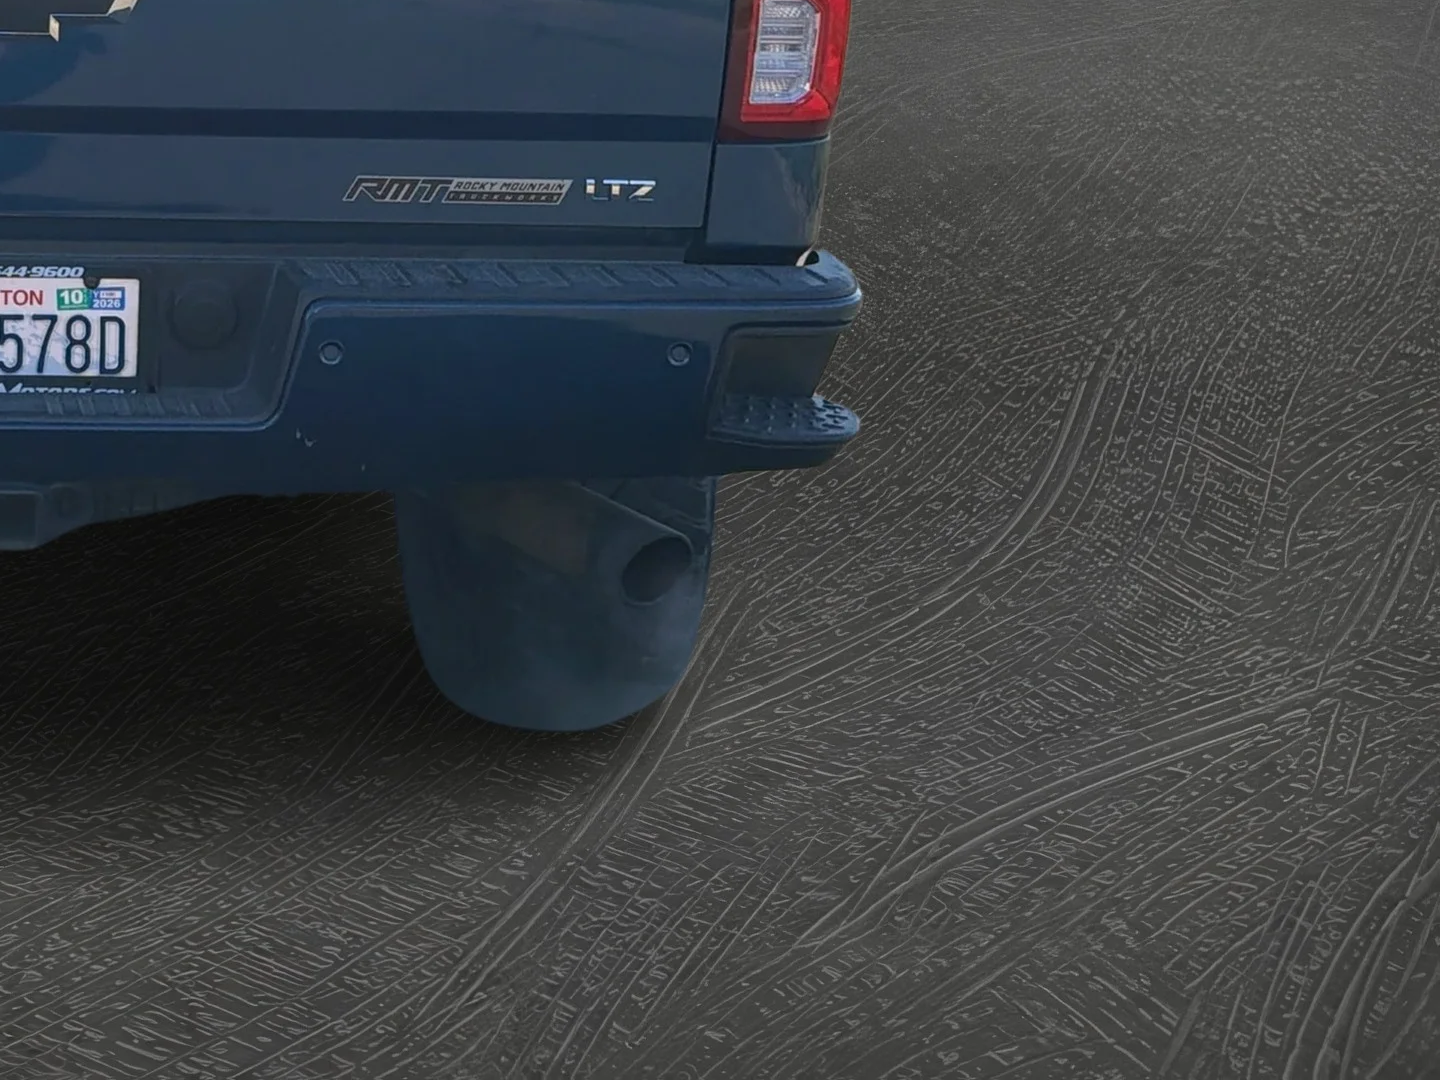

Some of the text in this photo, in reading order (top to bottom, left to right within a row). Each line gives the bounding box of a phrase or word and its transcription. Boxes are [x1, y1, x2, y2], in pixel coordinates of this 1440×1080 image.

[453, 180, 566, 193] ROCKY MOUNTAIN
[585, 178, 657, 202] LTZ
[60, 289, 84, 305] 10
[92, 299, 121, 309] 2026
